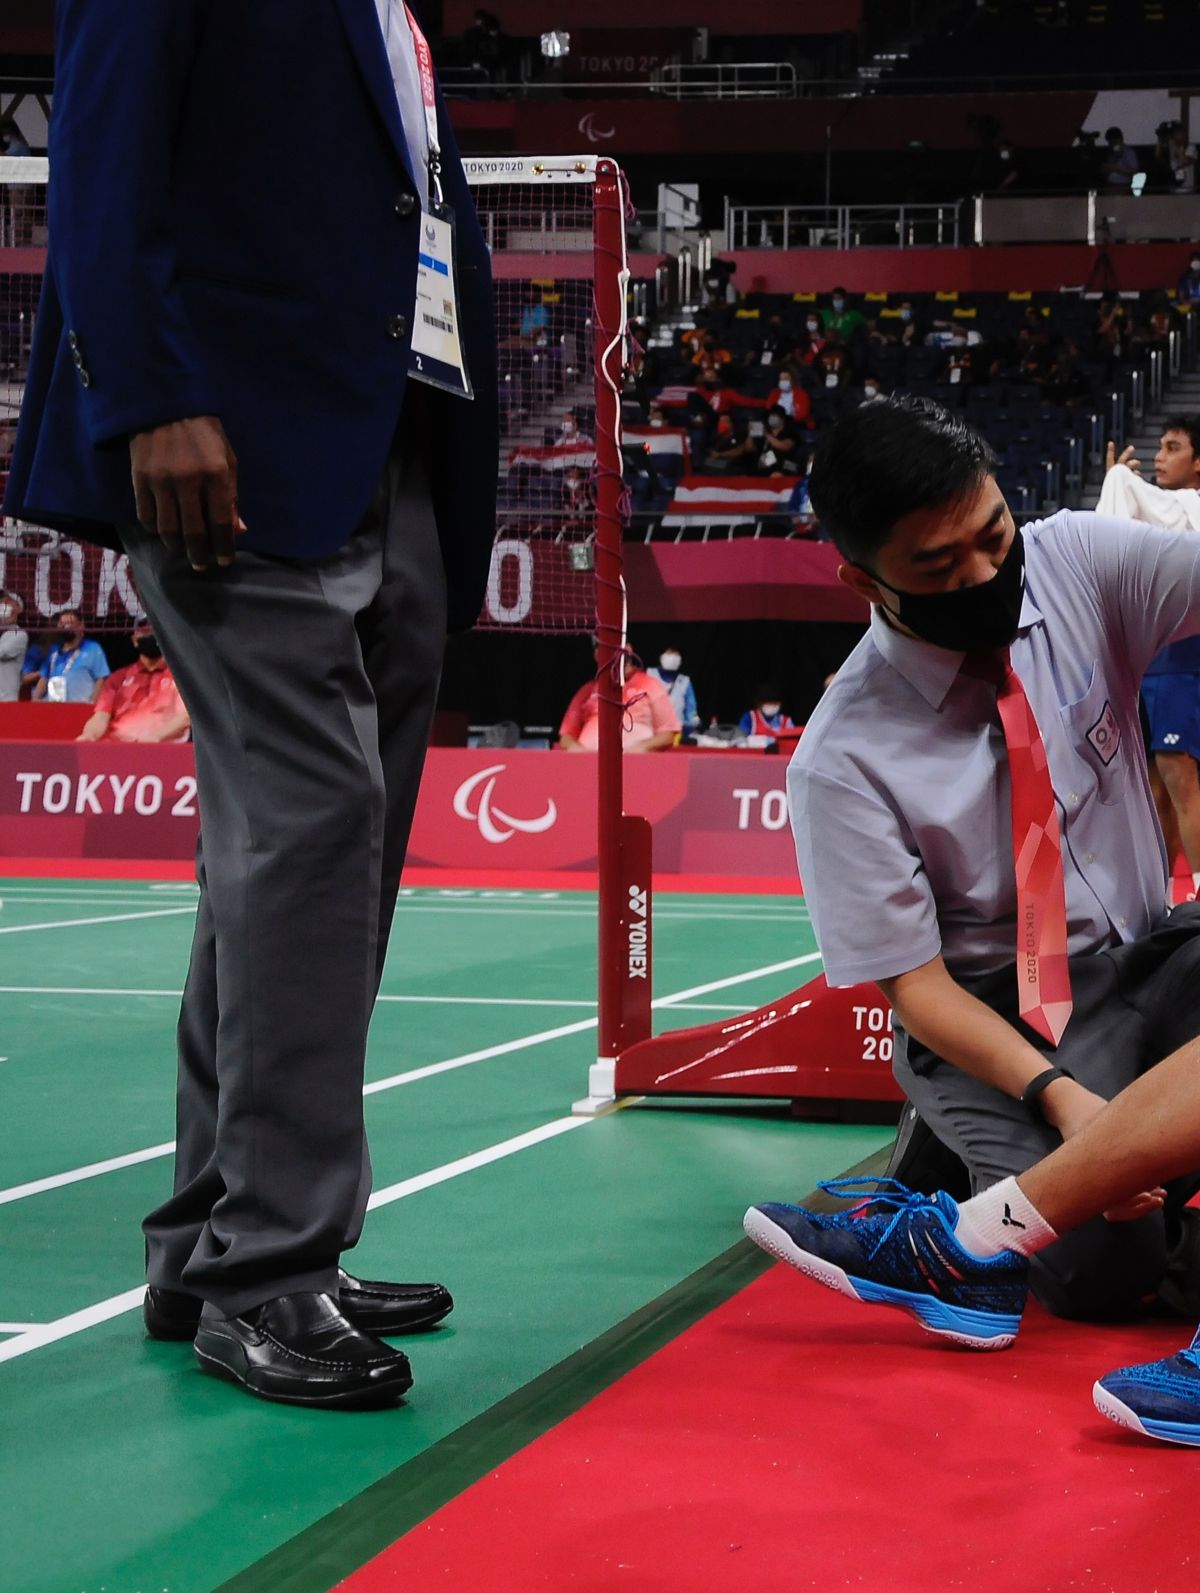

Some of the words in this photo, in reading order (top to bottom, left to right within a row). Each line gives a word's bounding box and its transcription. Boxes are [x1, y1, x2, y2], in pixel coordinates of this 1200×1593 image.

[578, 56, 636, 72] TOKYO
[464, 163, 498, 173] TOKYO
[499, 162, 524, 172] 2020
[0, 535, 147, 619] OK
[16, 772, 164, 816] TOKYO
[1025, 903, 1036, 948] TOKYO
[628, 919, 647, 979] YONEX
[1026, 951, 1037, 984] 2020
